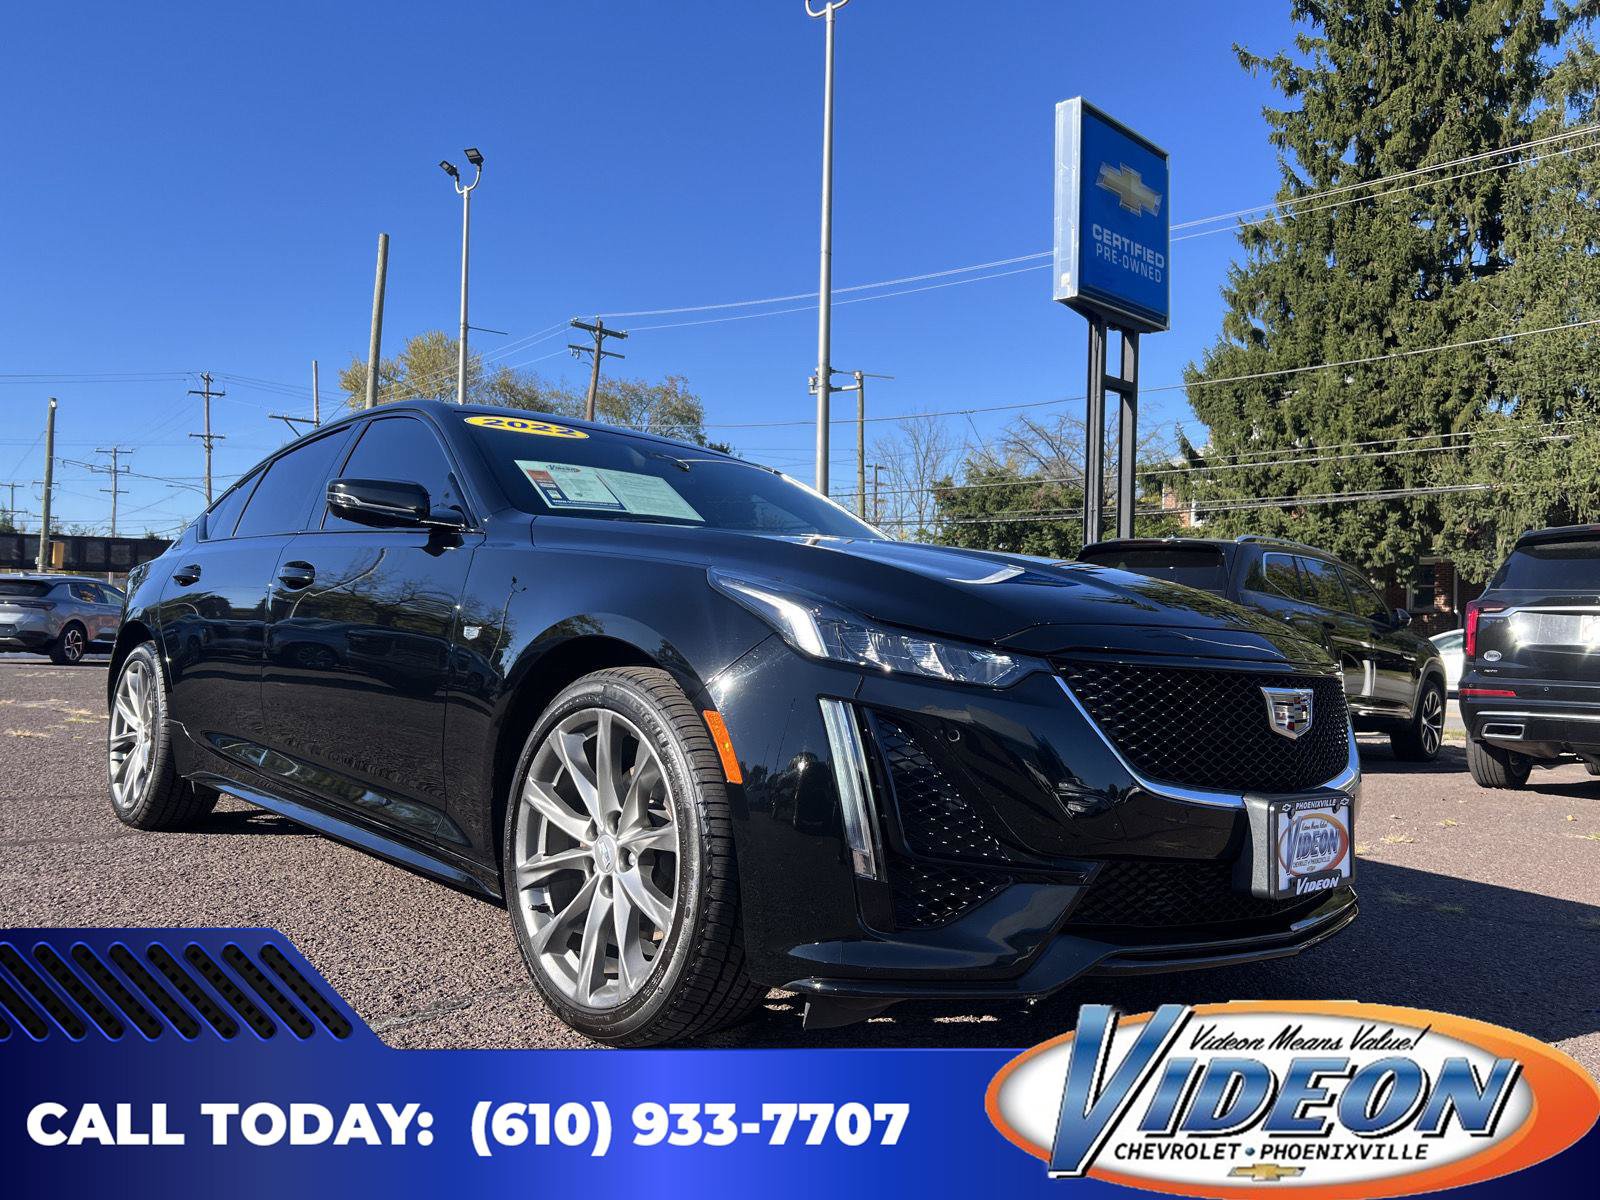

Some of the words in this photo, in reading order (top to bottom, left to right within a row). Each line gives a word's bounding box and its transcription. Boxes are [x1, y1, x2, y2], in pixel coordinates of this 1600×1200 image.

[1092, 223, 1165, 268] CERTIFIED
[1096, 242, 1162, 284] PRE-OWNED
[482, 418, 577, 436] 2022
[1296, 799, 1335, 809] PHOENIXVILLE
[1286, 816, 1339, 875] VIDEON
[1297, 877, 1339, 895] VIDEON
